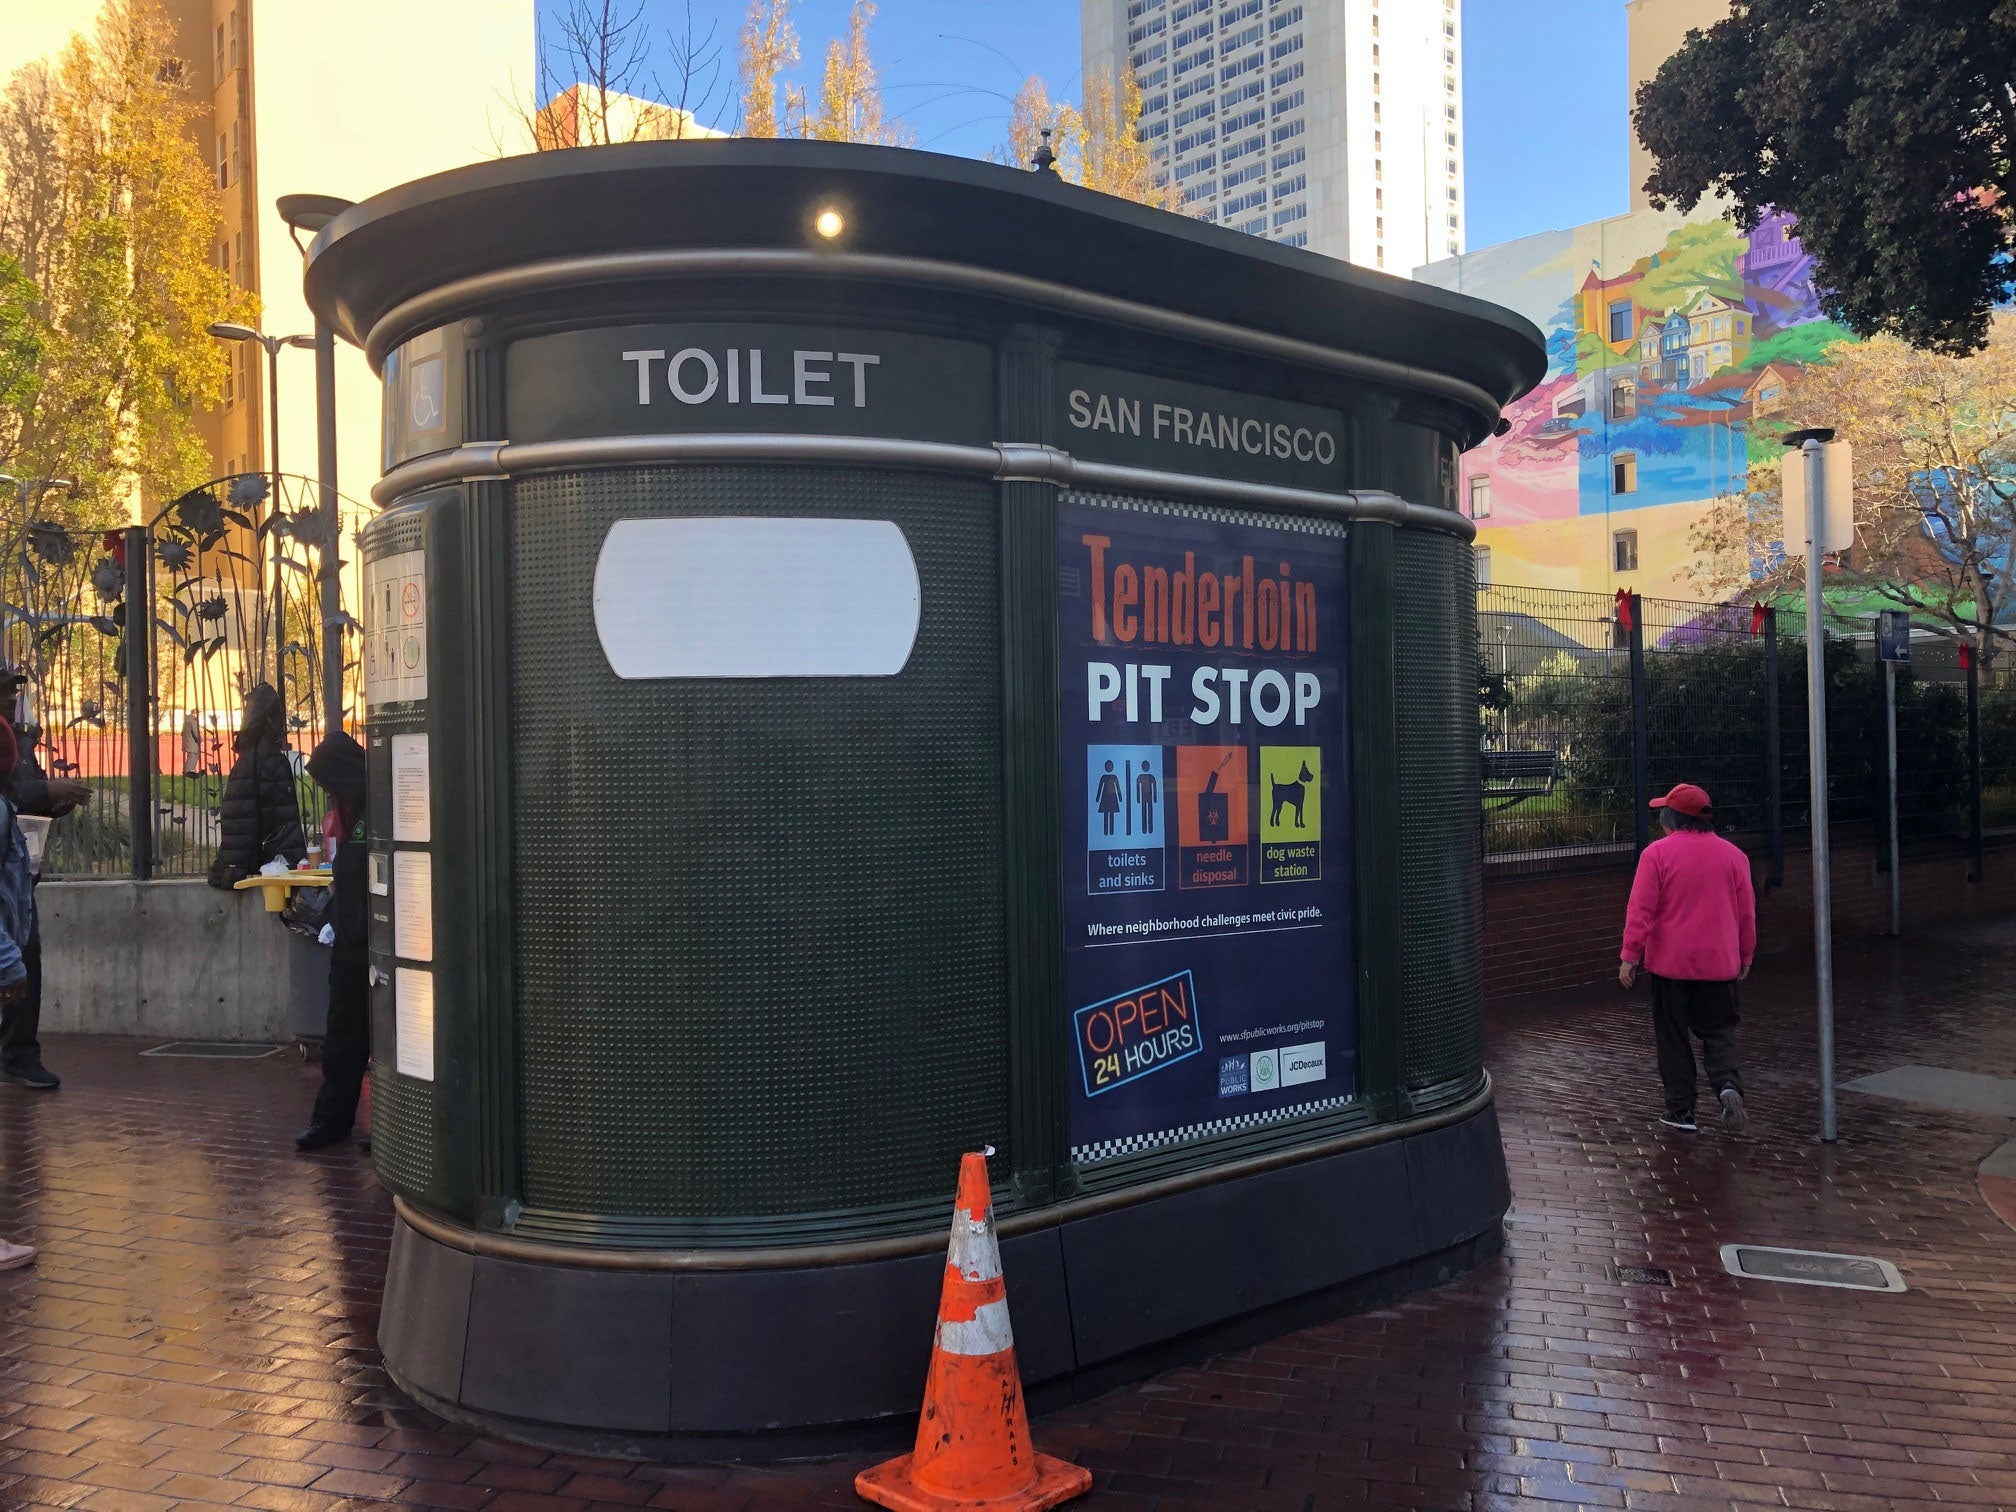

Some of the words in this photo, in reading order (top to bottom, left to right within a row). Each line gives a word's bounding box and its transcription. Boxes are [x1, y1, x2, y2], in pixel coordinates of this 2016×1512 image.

[622, 348, 880, 407] TOILET
[1069, 390, 1140, 436] SAN
[1153, 404, 1335, 465] FRANCISCO
[1082, 534, 1317, 652] Tenderloin
[1088, 662, 1171, 723] PIT
[1190, 666, 1321, 727] STOP
[1107, 853, 1147, 867] toilets
[1196, 849, 1233, 863] needle
[1266, 846, 1285, 862] dog
[1287, 846, 1316, 858] waste
[1193, 867, 1237, 884] disposal
[1274, 863, 1308, 878] station
[1099, 874, 1121, 888] and
[1124, 872, 1155, 887] sinks
[1088, 922, 1123, 936] Where
[1126, 916, 1200, 935] neighborhood
[1201, 913, 1251, 927] challenges
[1252, 910, 1276, 922] meet
[1277, 908, 1297, 920] civic
[1298, 906, 1323, 922] pride.
[1087, 981, 1188, 1053] OPEN
[1219, 1019, 1325, 1043] www.sfpublicworks.org/pitstop
[1094, 1053, 1120, 1085] 24
[1125, 1024, 1193, 1072] HOURS
[1289, 1059, 1325, 1072] JCDecaux
[1220, 1073, 1247, 1087] PUBLIC
[1220, 1083, 1247, 1095] WORKS
